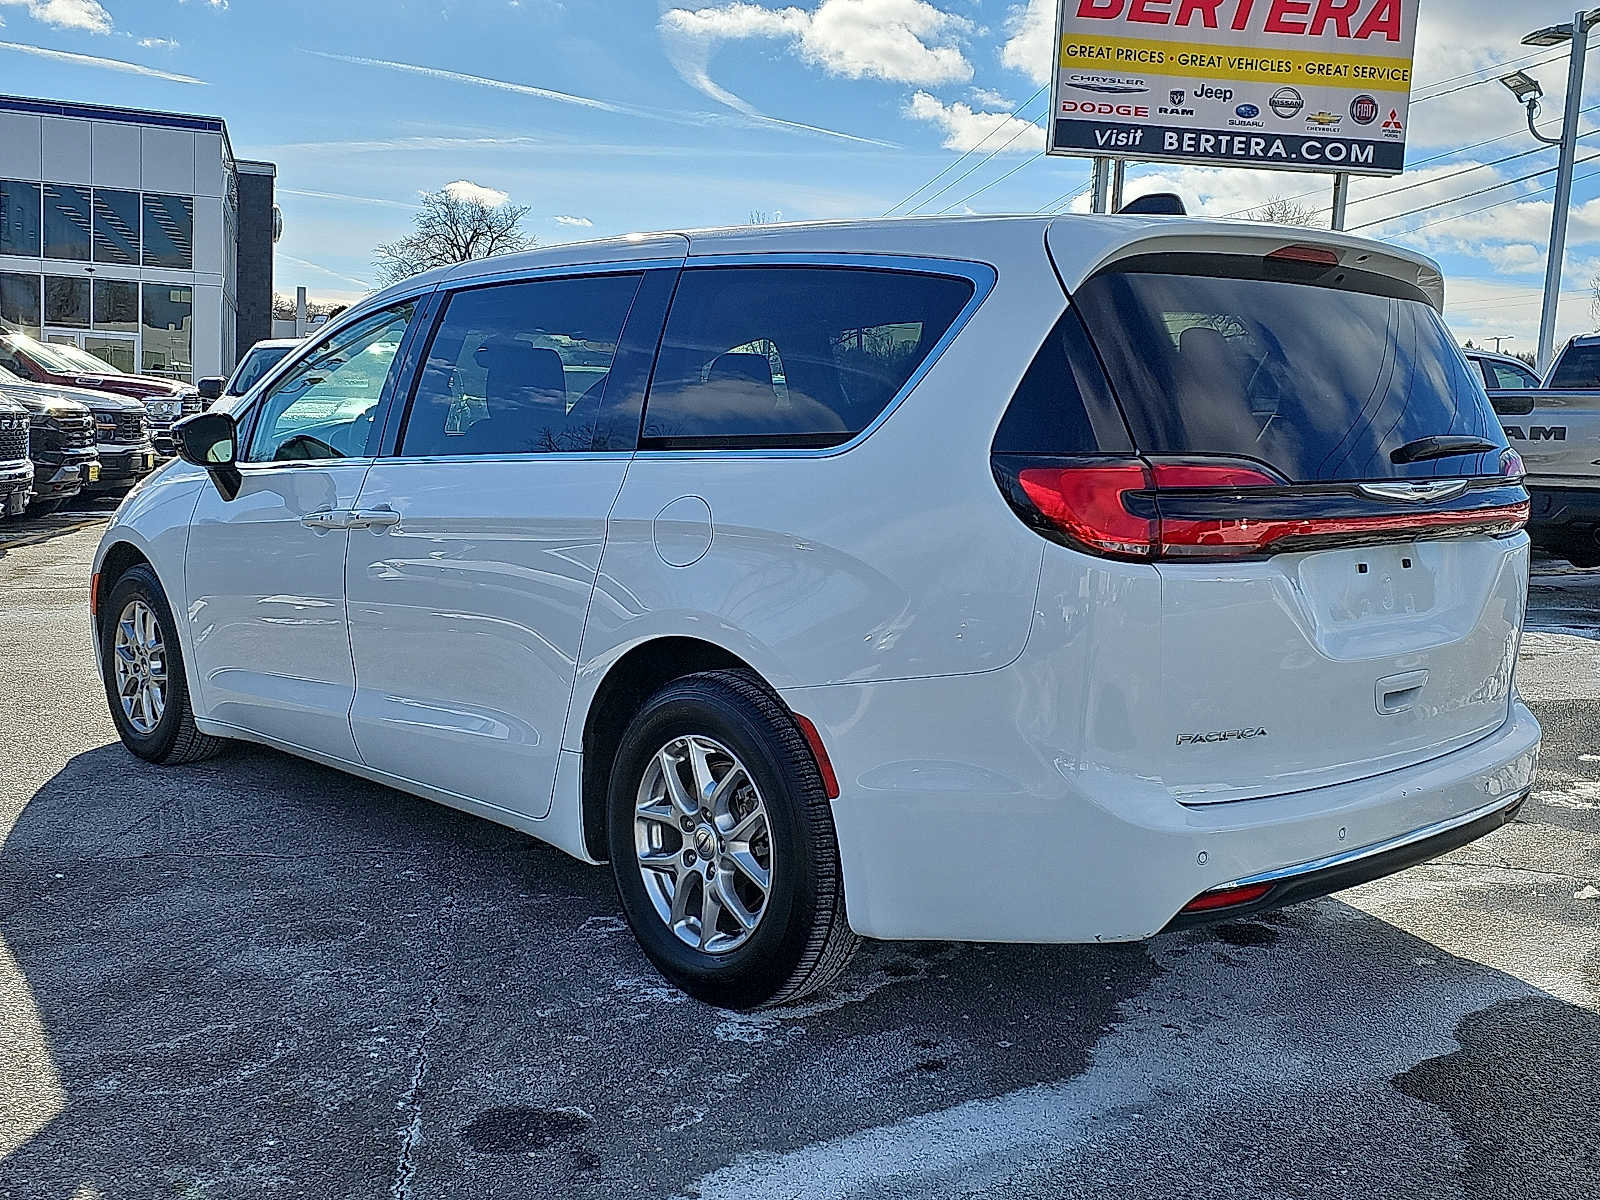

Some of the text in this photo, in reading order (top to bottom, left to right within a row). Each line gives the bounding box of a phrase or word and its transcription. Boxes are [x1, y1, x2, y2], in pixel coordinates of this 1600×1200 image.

[1066, 44, 1409, 82] GREAT PRICES GREAT VEHICLES GREAT SERVICE
[1070, 74, 1145, 86] CHRYSLER
[1194, 83, 1233, 102] Jeep
[1061, 101, 1149, 118] DODGE
[1158, 107, 1194, 116] RAM
[1271, 99, 1300, 109] NISSAN
[1356, 104, 1375, 118] FIAT
[1228, 119, 1265, 128] SUBARU
[1094, 129, 1375, 164] Visit BERTERA.COM
[1502, 426, 1567, 441] AM
[1175, 726, 1268, 745] PACIFICA
